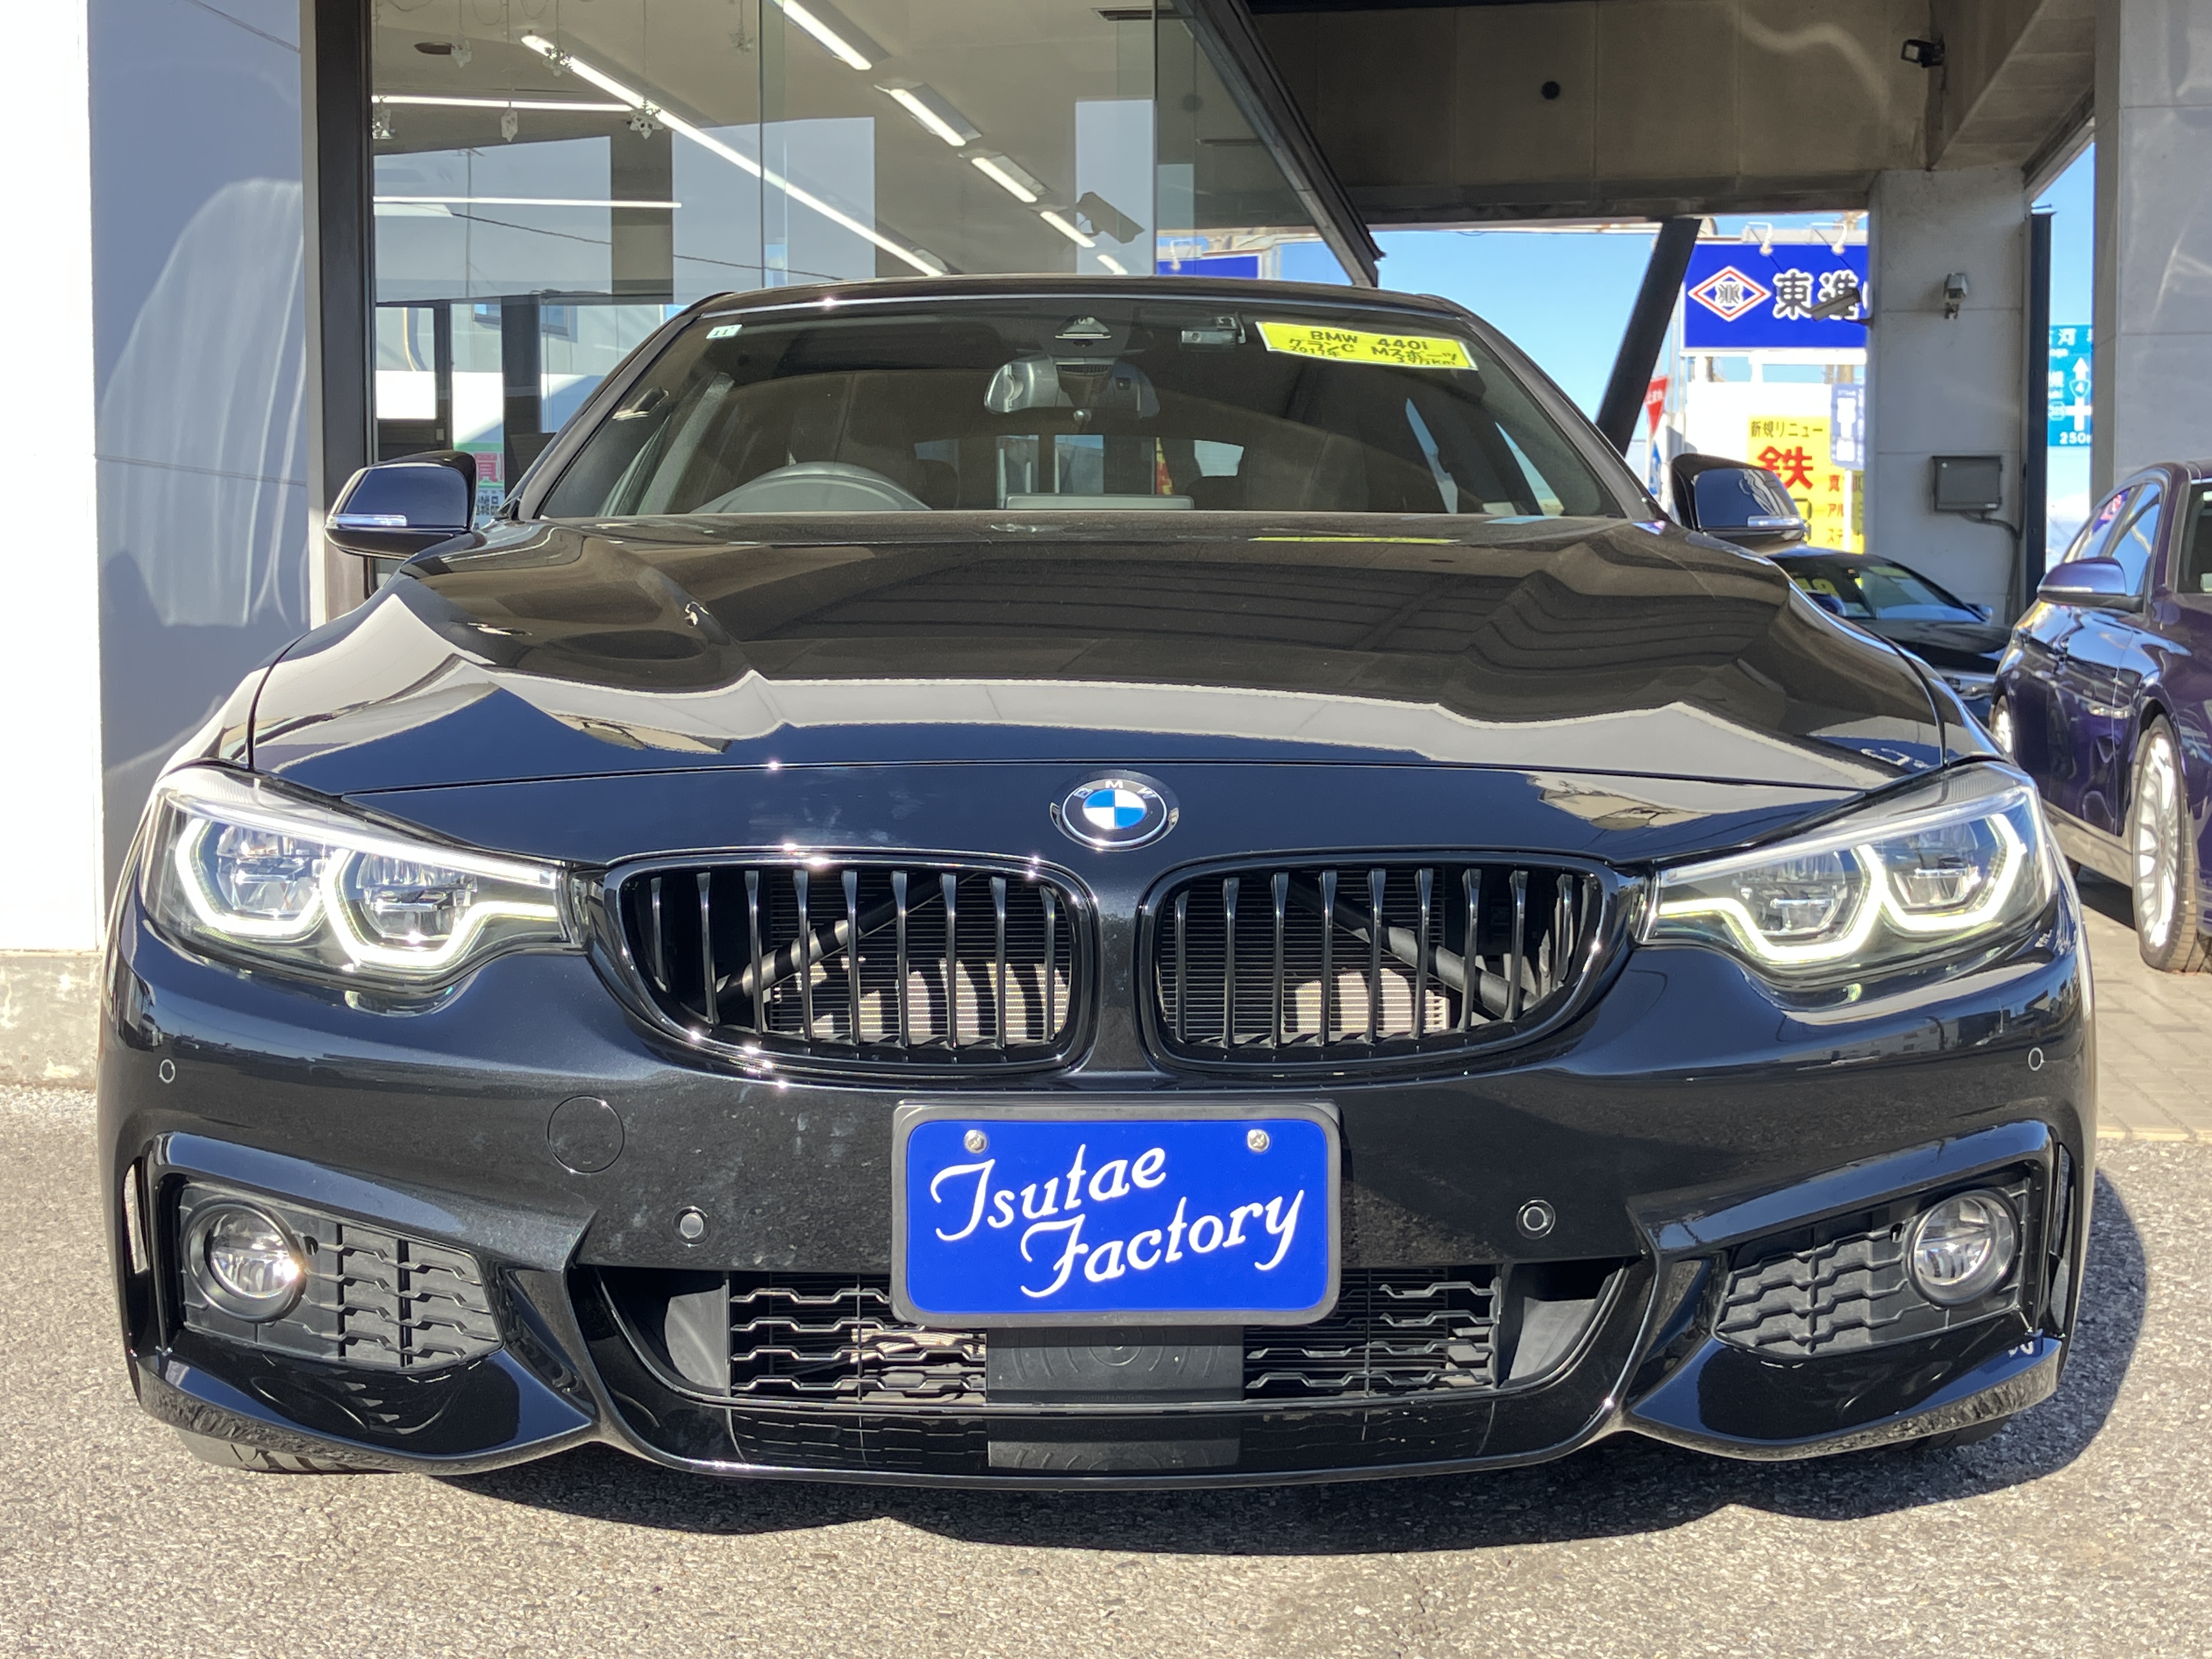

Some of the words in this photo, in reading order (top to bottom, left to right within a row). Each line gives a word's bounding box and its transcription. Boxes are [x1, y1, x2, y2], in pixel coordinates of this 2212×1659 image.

[1311, 331, 1358, 343] BMW
[1377, 338, 1429, 350] 440i
[475, 453, 504, 483] 買
[1757, 445, 1814, 490] 鉄
[1074, 780, 1158, 799] BMW
[1020, 1189, 1305, 1298] Factory
